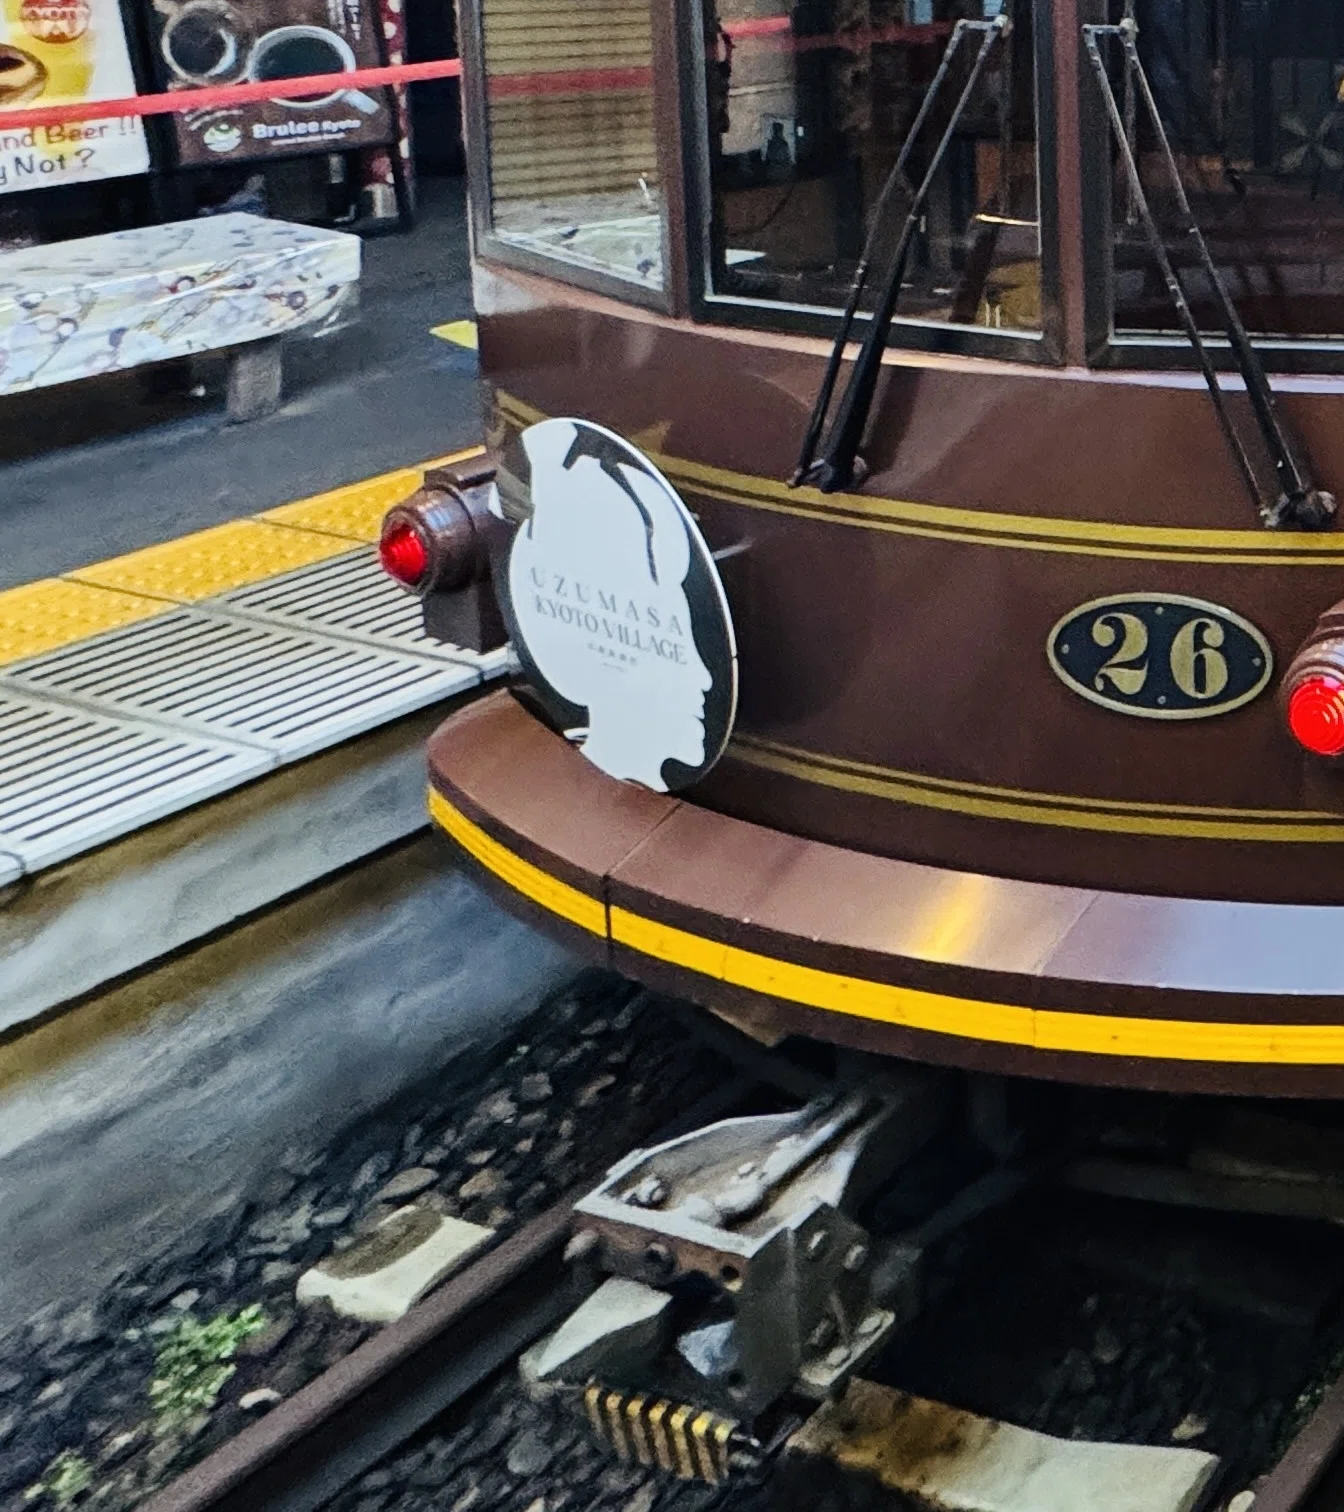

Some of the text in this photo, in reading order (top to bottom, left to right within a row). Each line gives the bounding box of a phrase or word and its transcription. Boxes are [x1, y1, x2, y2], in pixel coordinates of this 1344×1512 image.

[0, 127, 37, 152] nd
[45, 123, 108, 144] Beer
[252, 121, 319, 138] Brulee
[15, 154, 66, 176] Not
[531, 566, 684, 637] UZUMASA
[1091, 611, 1228, 700] 26
